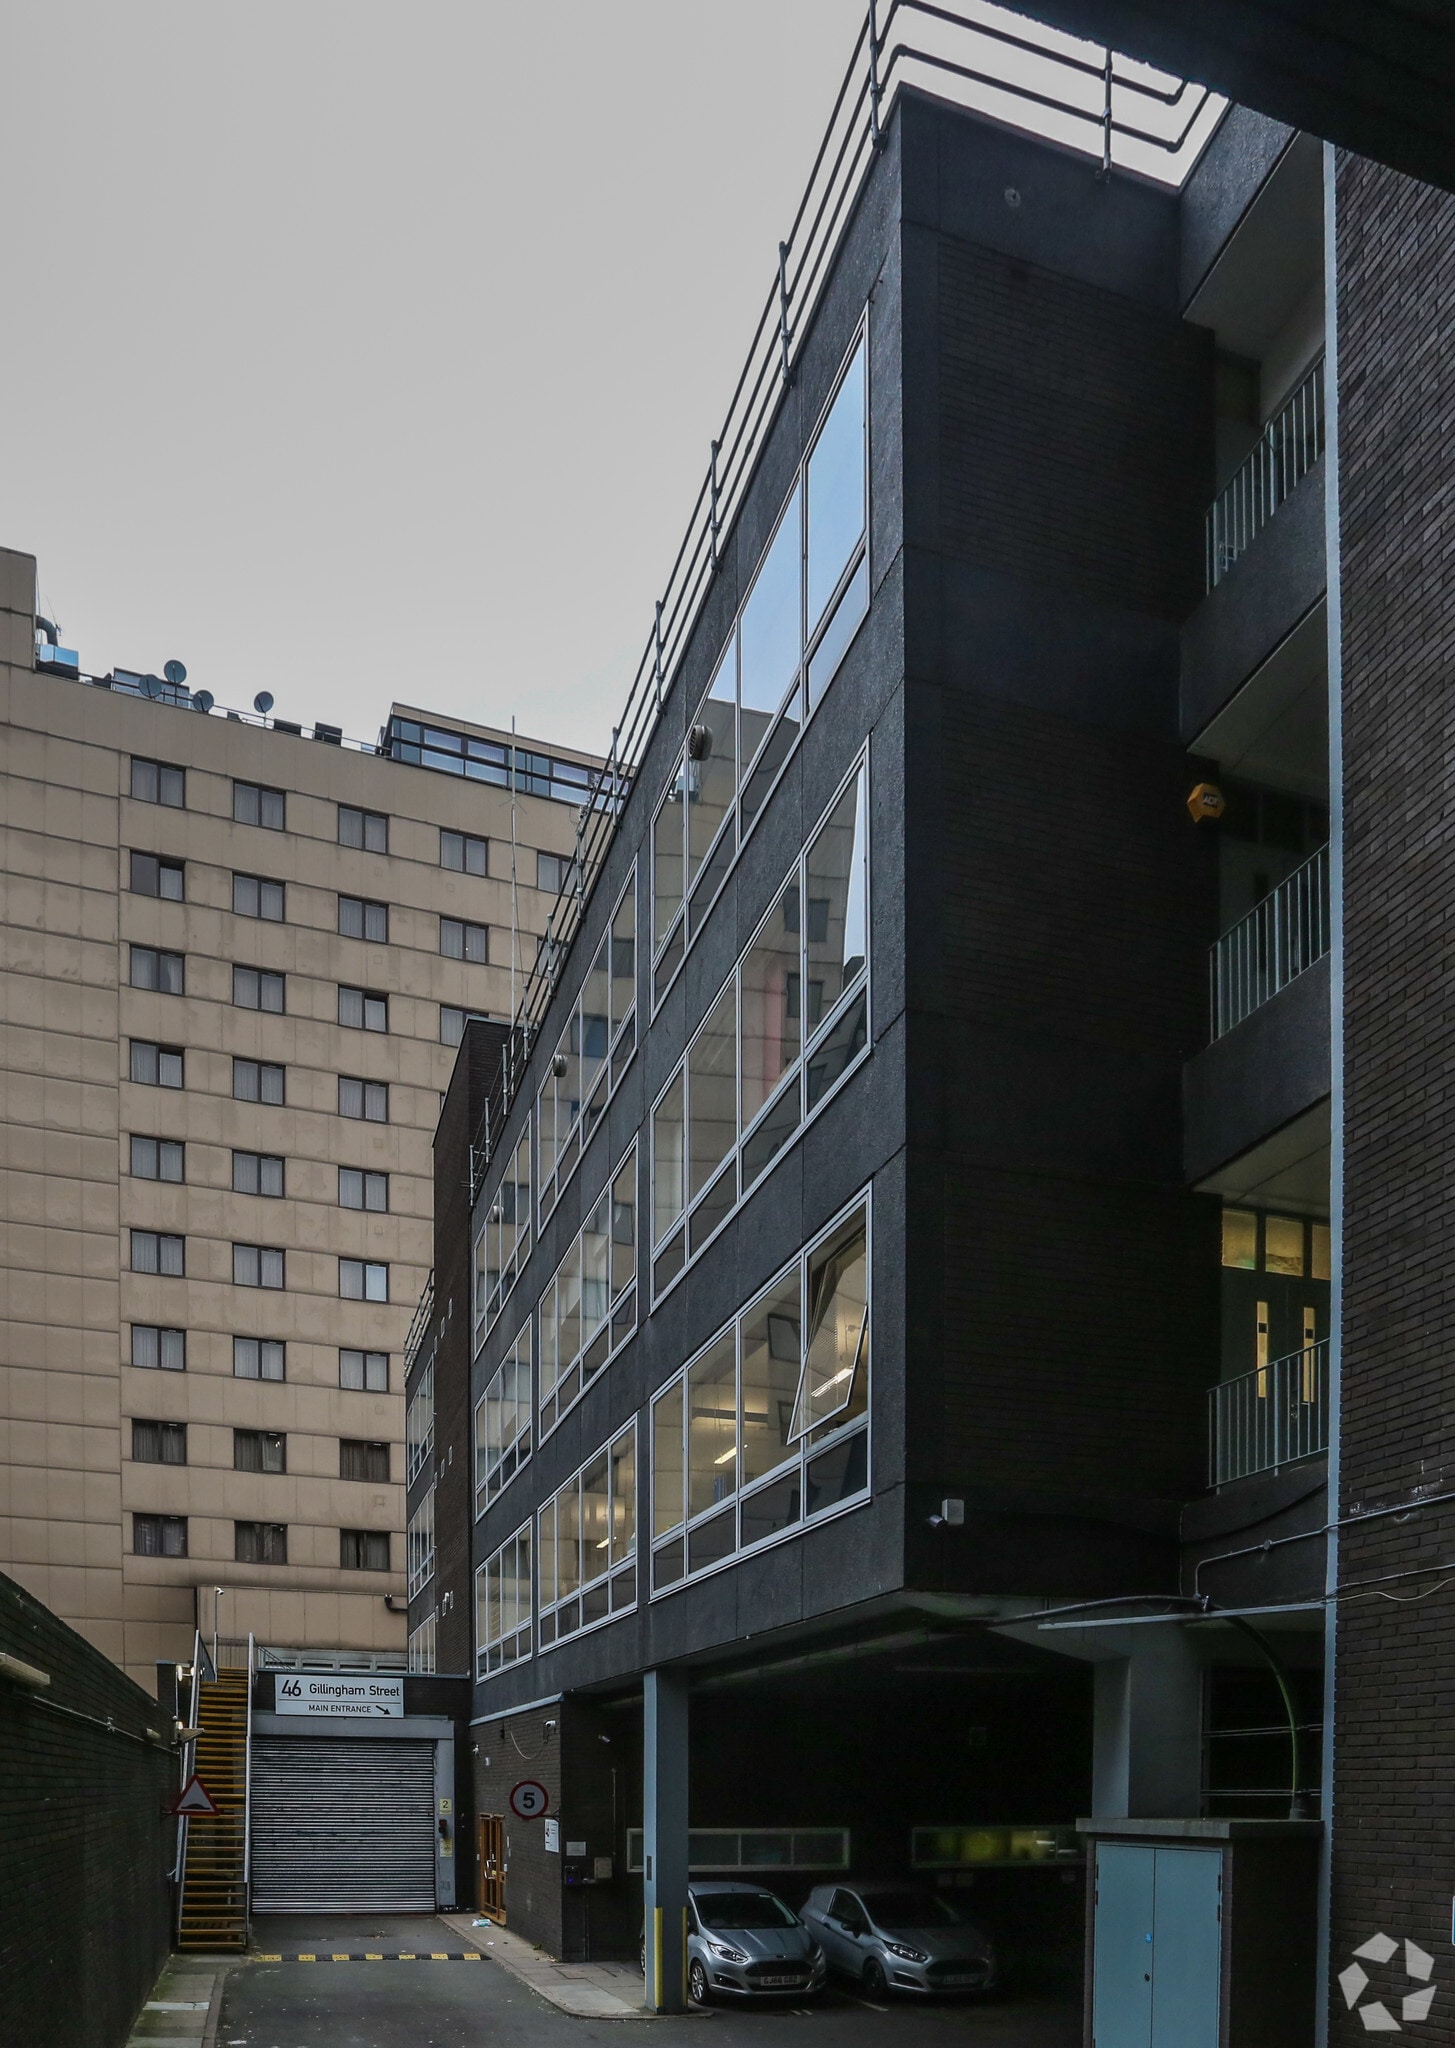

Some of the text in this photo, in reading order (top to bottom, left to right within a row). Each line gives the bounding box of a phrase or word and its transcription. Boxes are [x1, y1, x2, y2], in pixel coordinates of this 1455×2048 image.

[281, 1679, 400, 1697] 46 Gillingham Street
[308, 1704, 372, 1713] MAIN ENTRANCE
[442, 1800, 449, 1809] 2
[523, 1792, 535, 1809] 5
